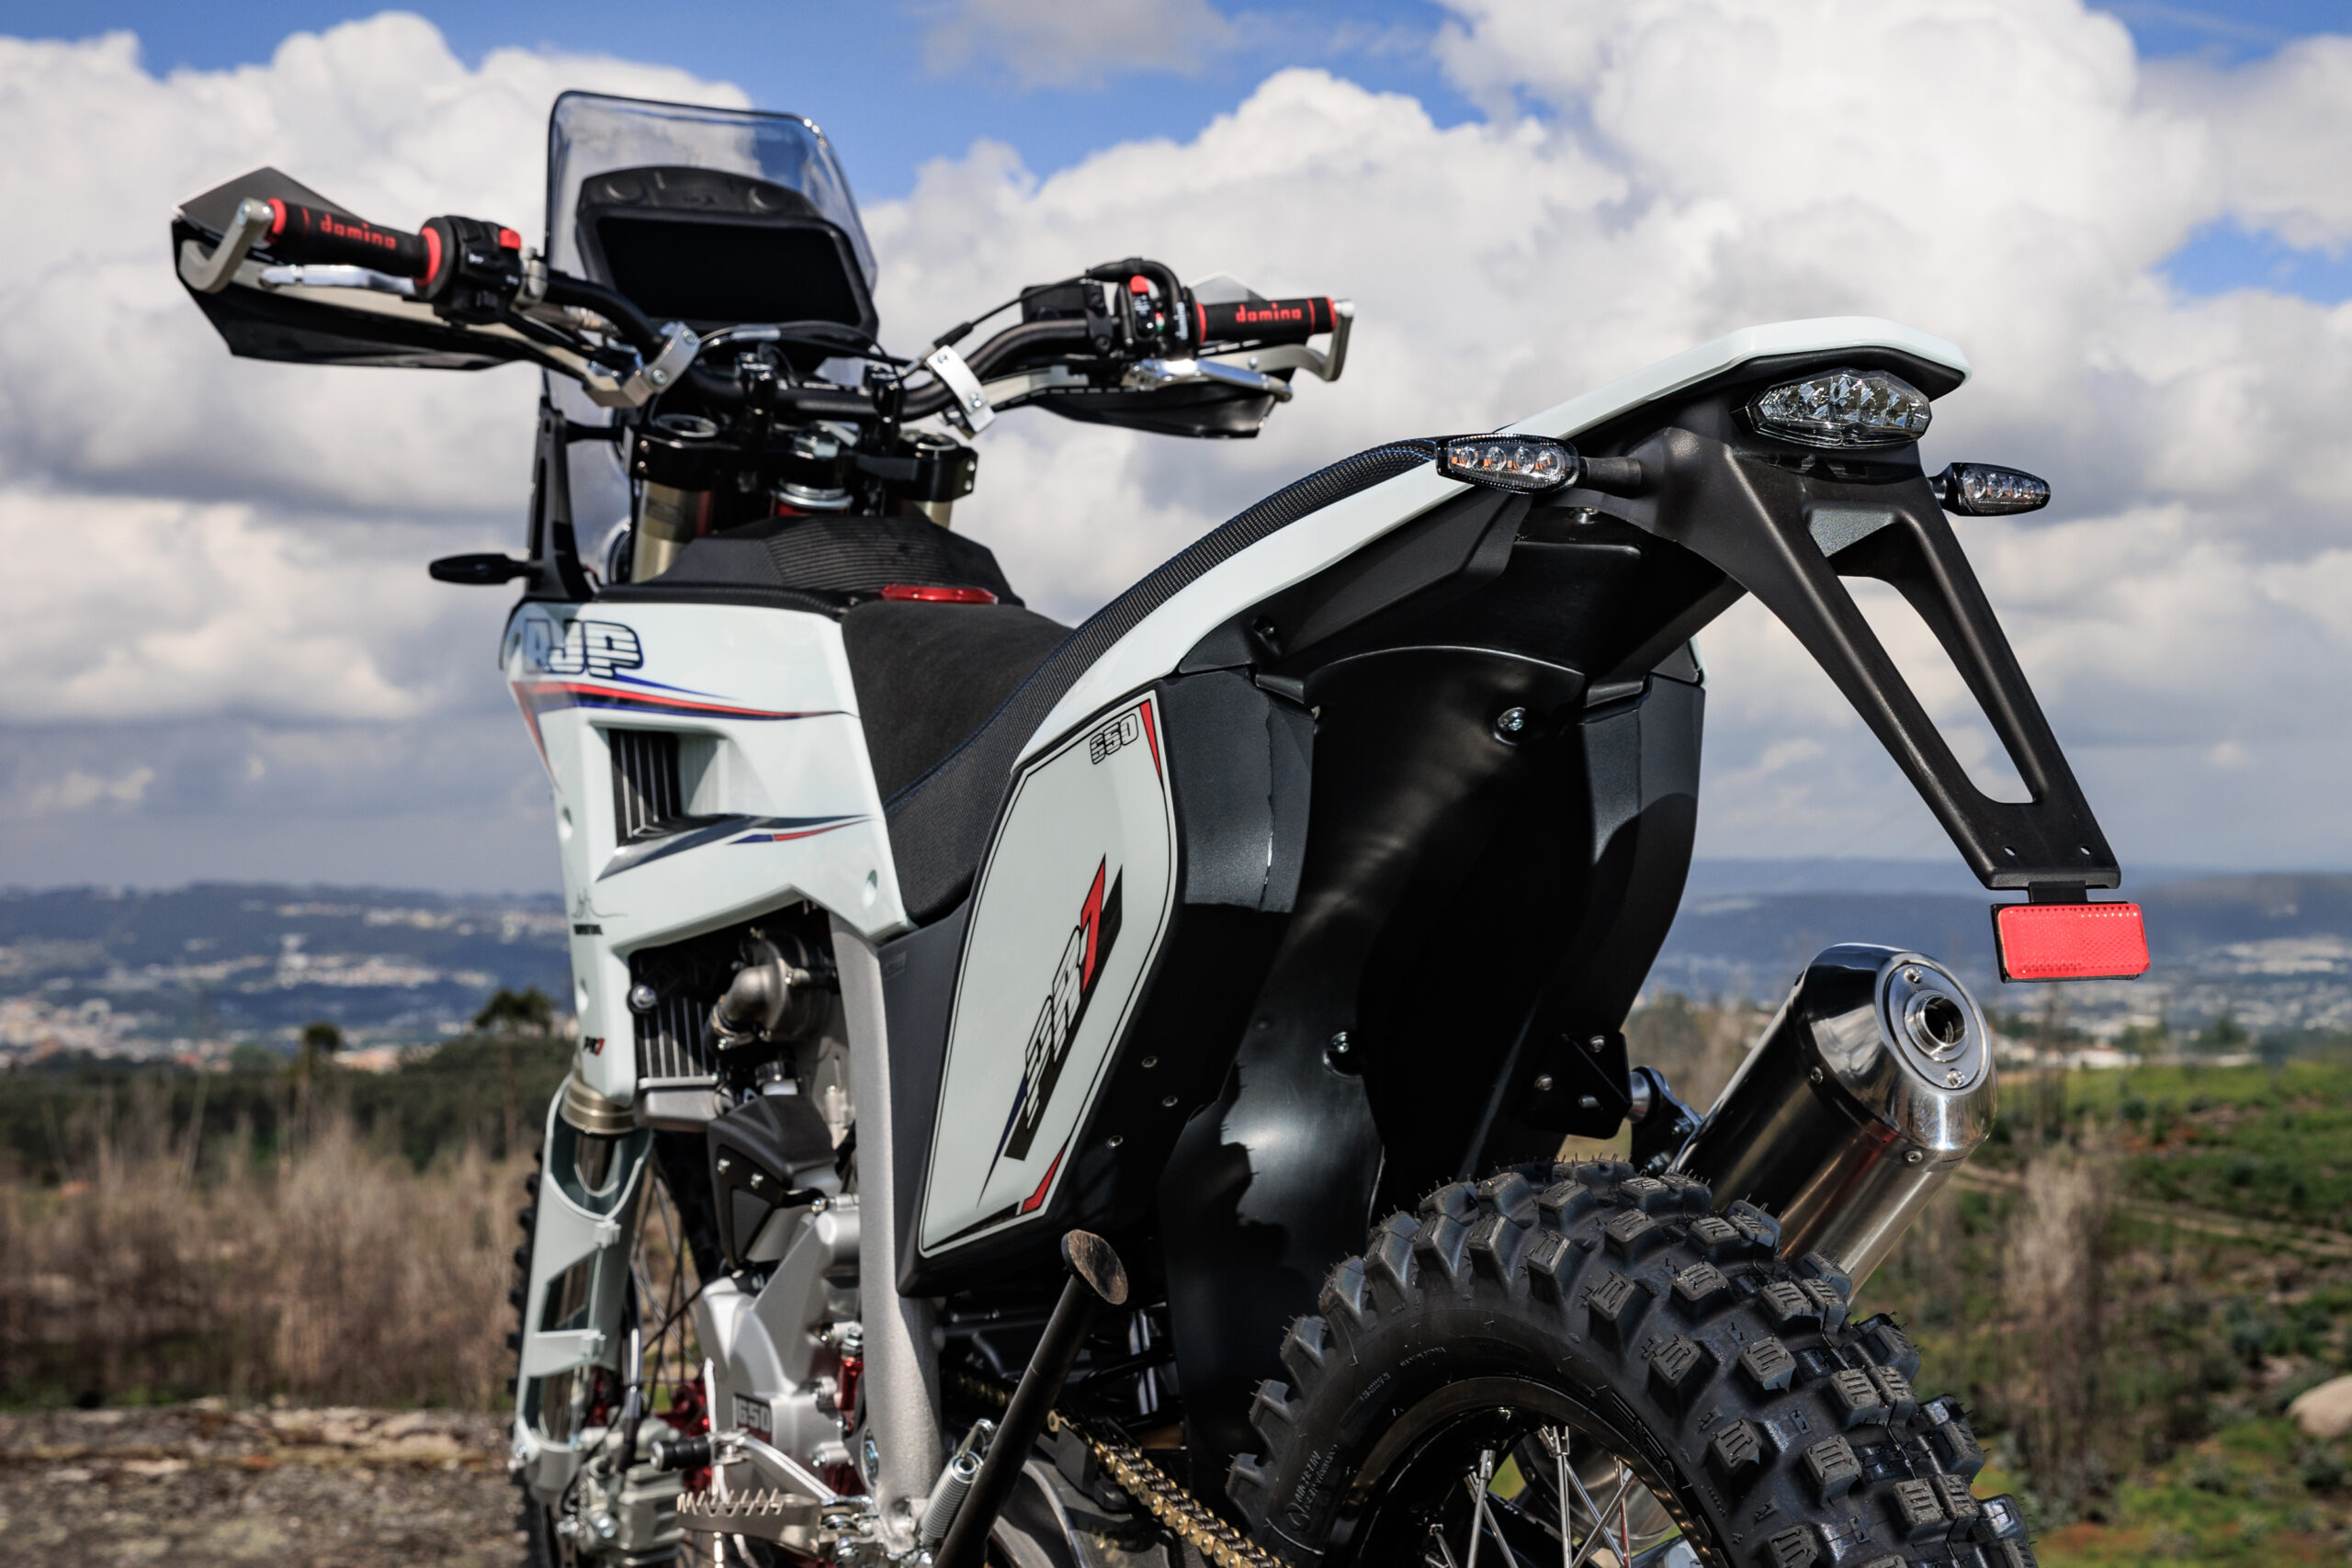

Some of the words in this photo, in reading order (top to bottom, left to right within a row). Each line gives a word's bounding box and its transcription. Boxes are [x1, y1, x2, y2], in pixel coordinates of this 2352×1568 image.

[320, 212, 396, 250] domino
[1235, 301, 1302, 322] domino
[522, 618, 644, 680] AJP
[1024, 851, 1106, 1131] PR7
[736, 1397, 772, 1433] 650
